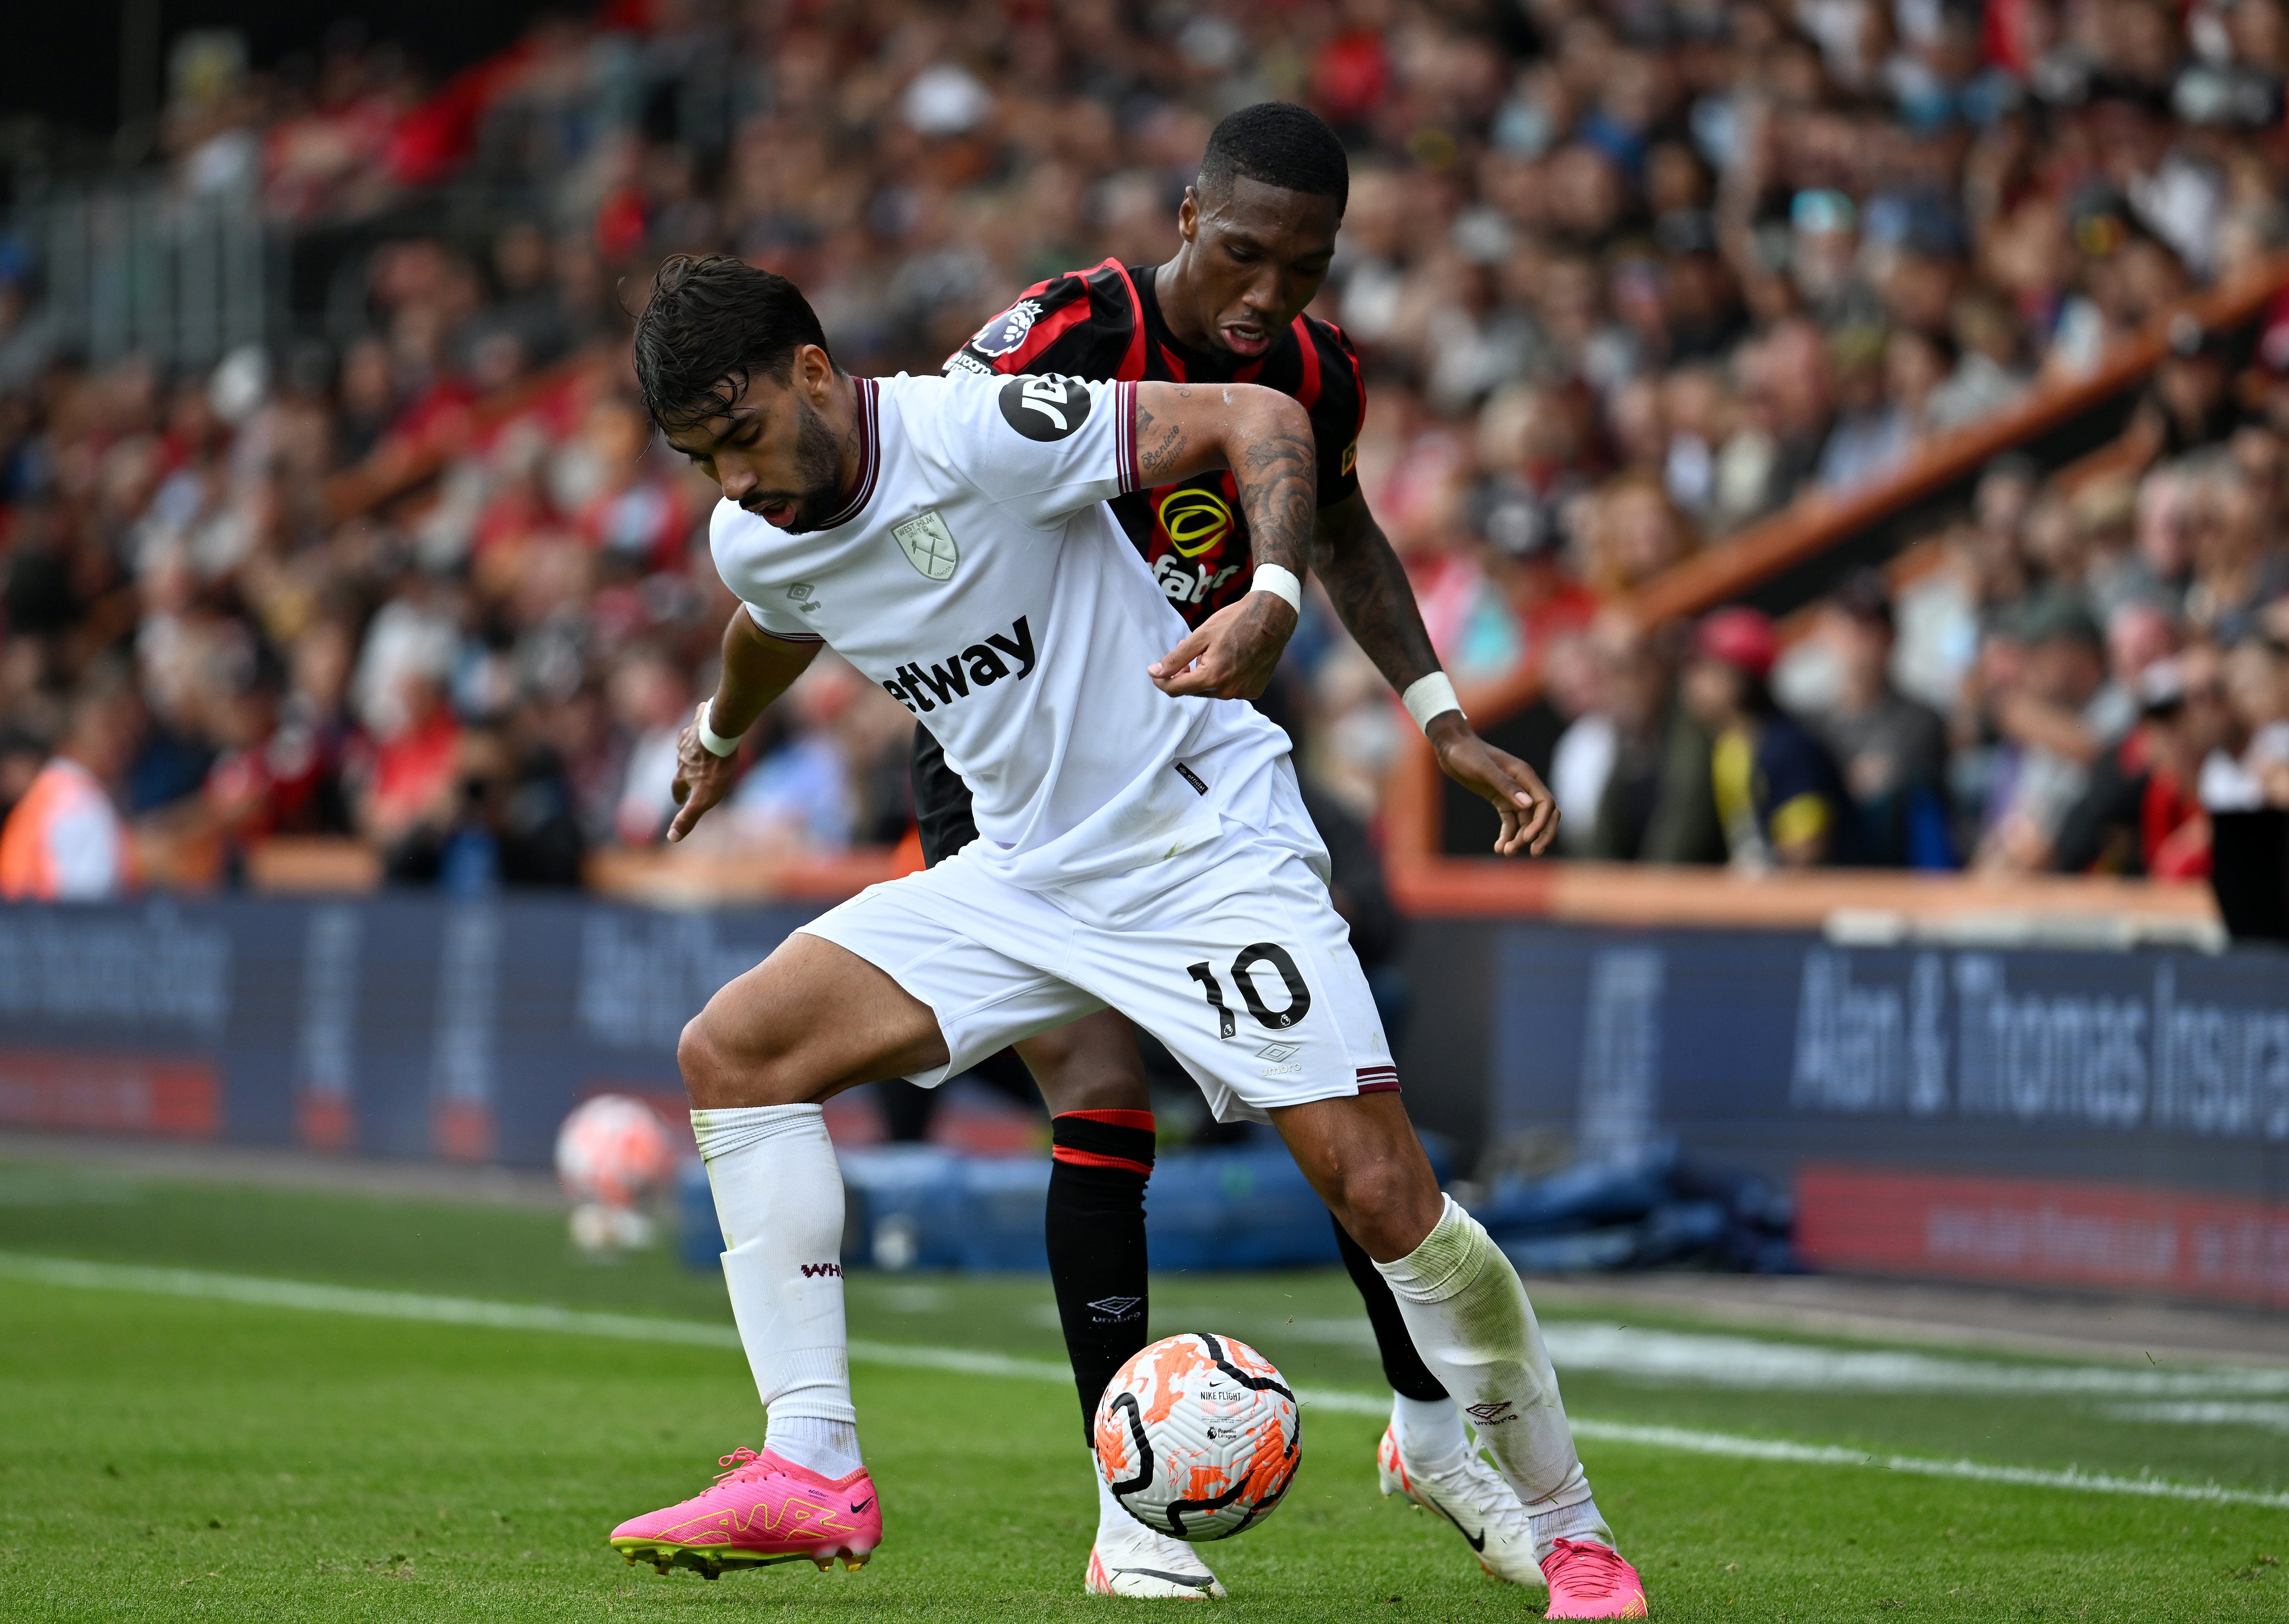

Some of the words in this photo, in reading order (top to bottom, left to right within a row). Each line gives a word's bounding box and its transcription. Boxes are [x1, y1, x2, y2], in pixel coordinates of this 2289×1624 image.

[1021, 376, 1068, 430] JD
[897, 523, 915, 536] WEST
[916, 515, 935, 527] HAM
[935, 565, 952, 576] LONDON
[1188, 774, 1205, 790] official
[1186, 942, 1311, 1041] 10
[1261, 1062, 1302, 1077] umbro
[1201, 1391, 1217, 1400] NIKE
[1219, 1392, 1241, 1401] FLIGHT
[1474, 1414, 1518, 1426] umbro
